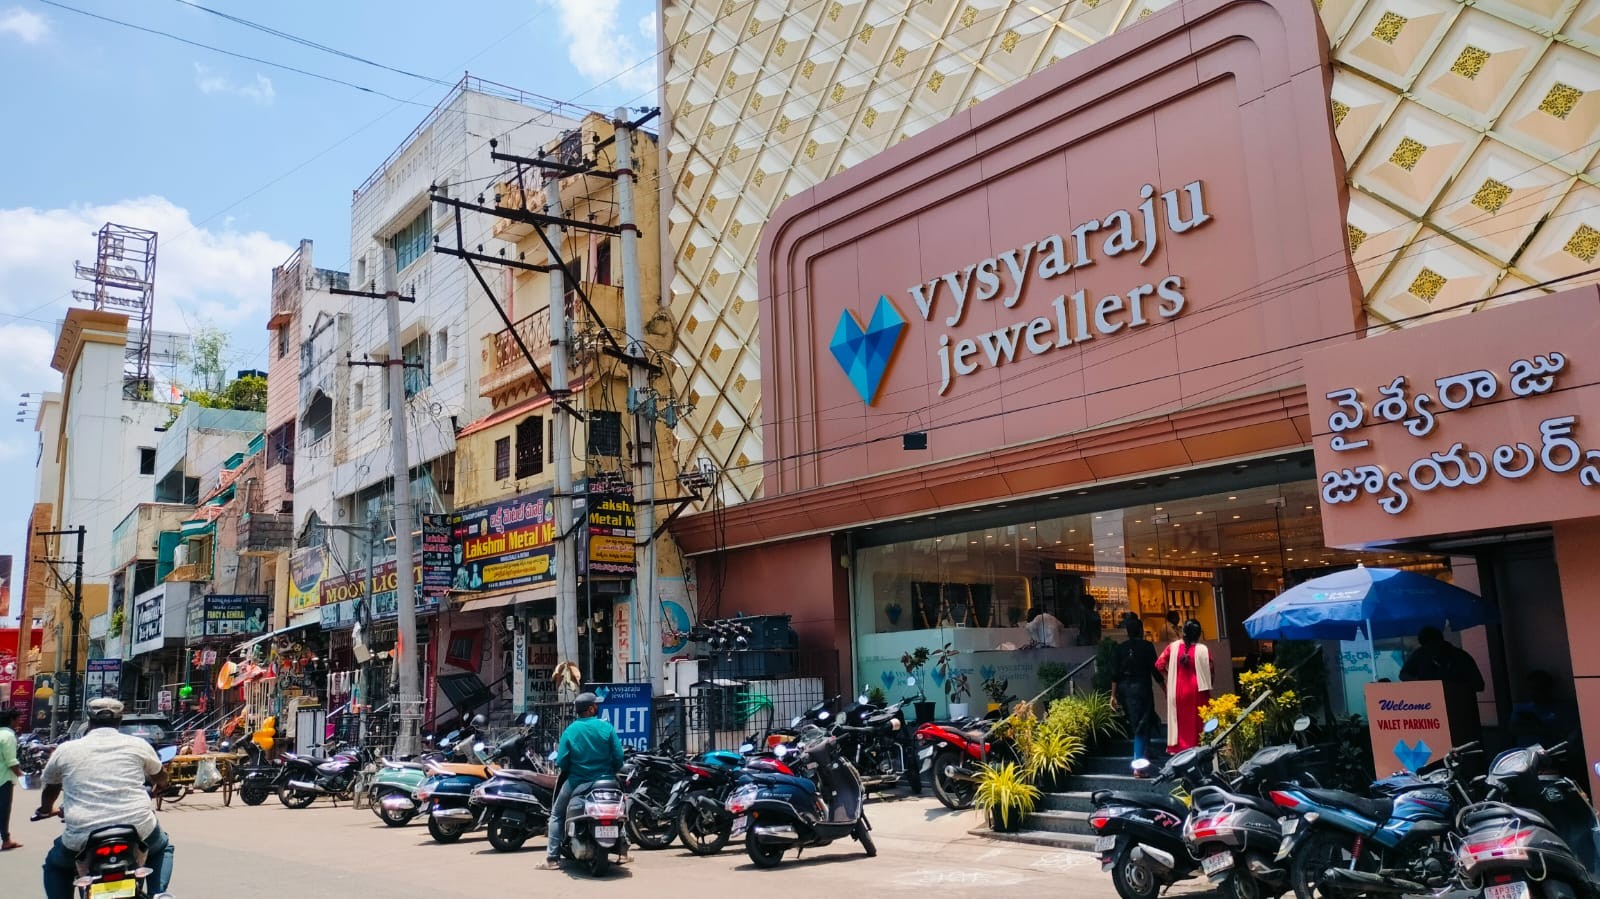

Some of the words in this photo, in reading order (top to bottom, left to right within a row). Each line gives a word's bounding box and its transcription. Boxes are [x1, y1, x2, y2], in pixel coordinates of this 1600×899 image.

[907, 180, 1212, 327] vysyaraju
[937, 275, 1185, 396] jewellers
[589, 512, 622, 526] Metal
[465, 534, 506, 559] Lakshmi
[508, 526, 539, 551] Metal
[542, 522, 556, 544] Ma
[326, 566, 423, 604] MOONLIGT
[610, 686, 641, 695] vysyaraju
[611, 692, 637, 700] jewellers
[1378, 699, 1432, 711] Welcome
[601, 706, 649, 733] ALET
[1377, 719, 1401, 731] VALET
[1403, 718, 1441, 730] PARKING
